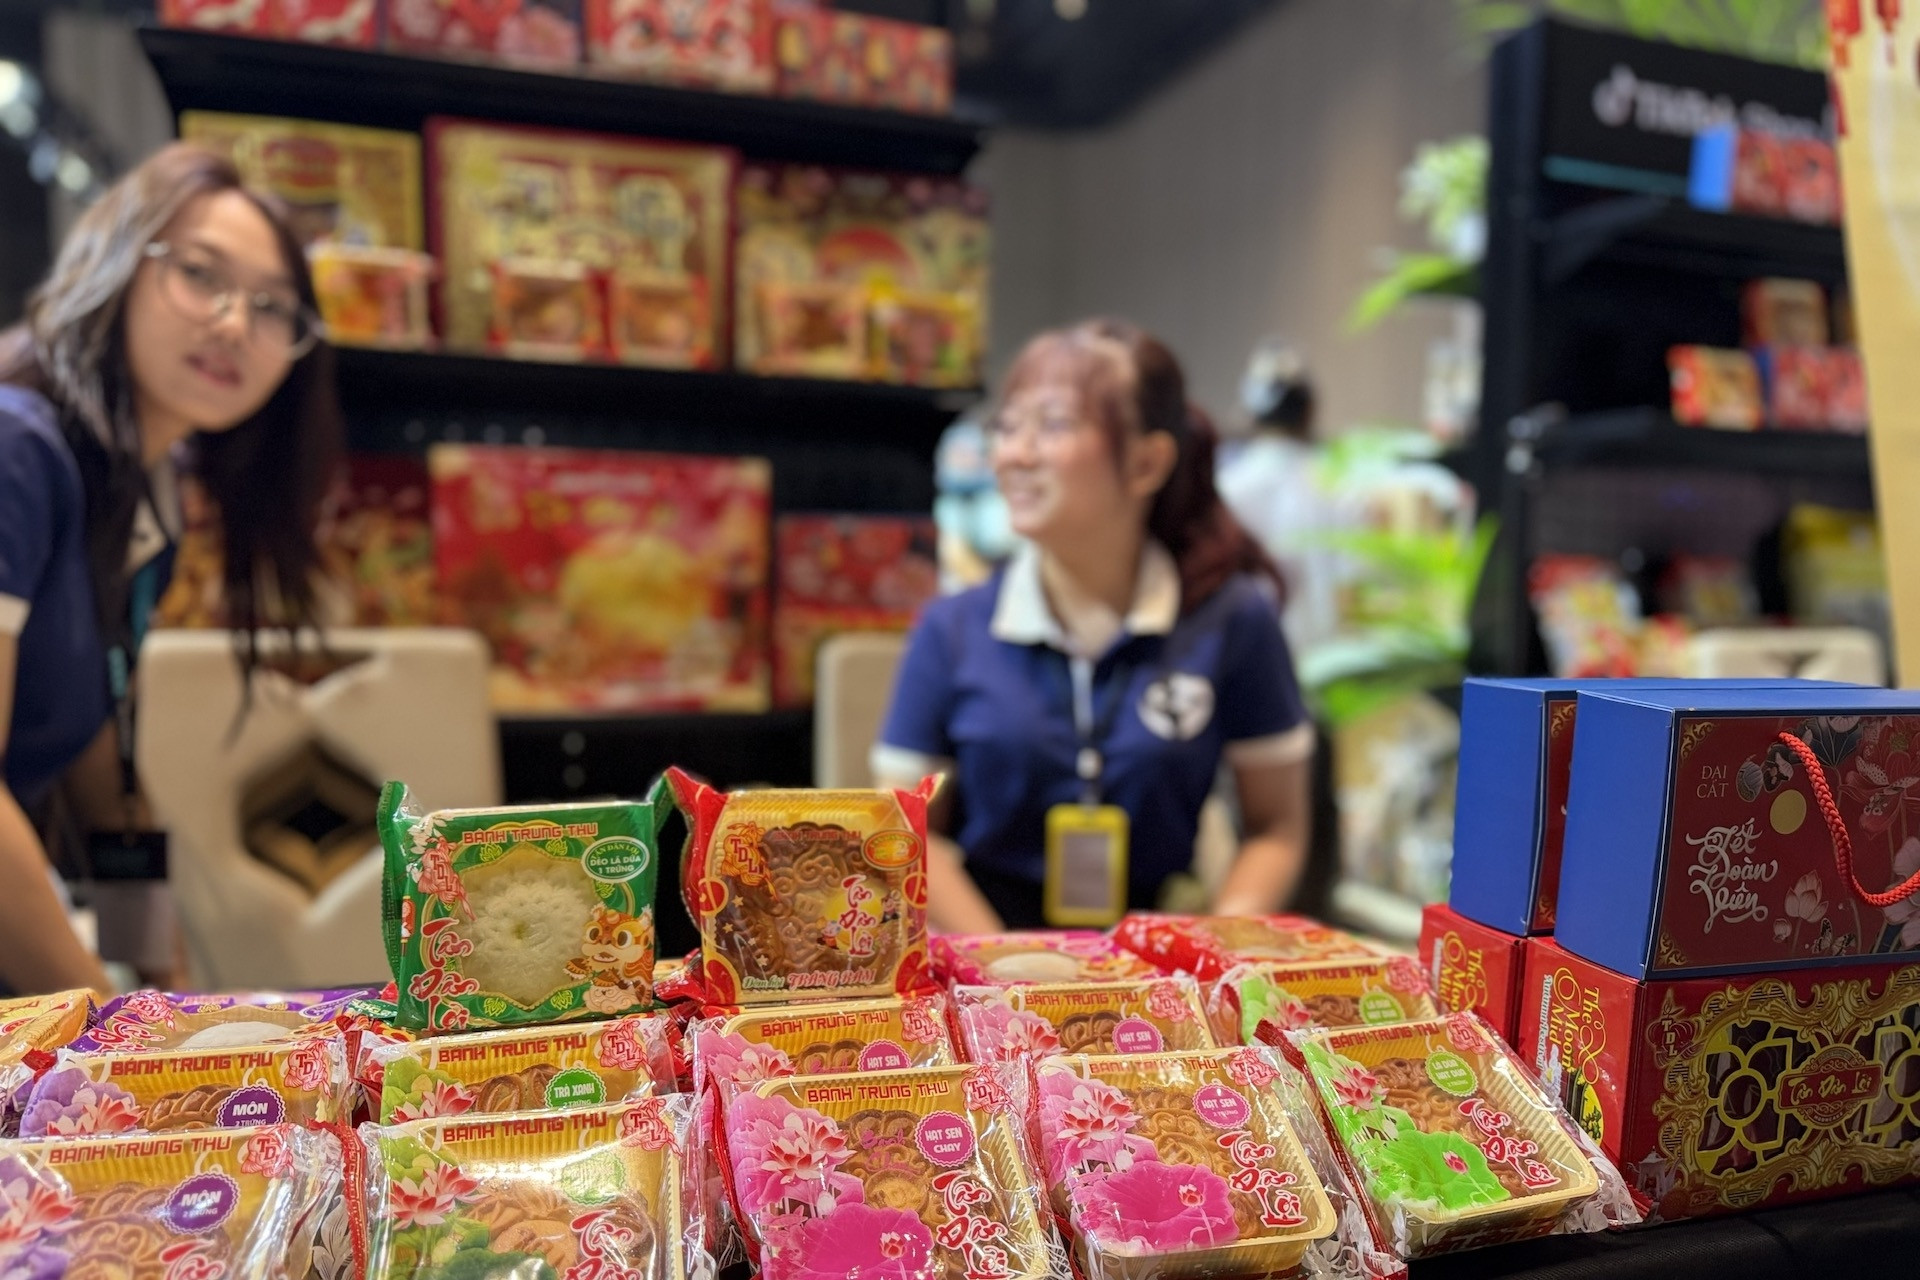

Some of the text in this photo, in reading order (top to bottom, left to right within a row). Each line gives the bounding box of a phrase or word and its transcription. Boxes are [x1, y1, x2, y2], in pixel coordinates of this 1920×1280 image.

[463, 822, 598, 845] BÁNH TRUNG THU
[730, 838, 761, 874] TDL
[429, 853, 458, 894] TDL
[1064, 993, 1109, 1006] TRUNG
[1114, 991, 1139, 1003] THU
[761, 1010, 890, 1037] BÁNH TRUNG THU
[905, 1011, 935, 1037] TDL
[1371, 1026, 1413, 1042] TRUNG
[1414, 1021, 1440, 1037] THU
[1550, 1002, 1564, 1045] Mid
[439, 1034, 587, 1063] BÁNH TRUNG THU
[606, 1033, 644, 1061] TDL
[1137, 1031, 1152, 1043] SEN
[1661, 1019, 1678, 1057] TDL
[111, 1052, 273, 1076] BÁNH TRUNG THU
[885, 1055, 901, 1067] SEN
[1188, 1057, 1219, 1071] THU
[573, 1083, 595, 1096] XANH
[807, 1079, 950, 1103] BÁNH TRUNG THU
[967, 1079, 1000, 1105] TDL
[232, 1101, 268, 1117] MÔN
[1220, 1098, 1237, 1109] SEN
[442, 1110, 607, 1143] BÁNH TRUNG THU
[629, 1112, 661, 1142] TDL
[925, 1127, 963, 1143] HẠT SEN
[50, 1135, 231, 1164] BÁNH TRUNG THU
[933, 1142, 961, 1153] CHAY
[181, 1187, 222, 1207] MÔN
